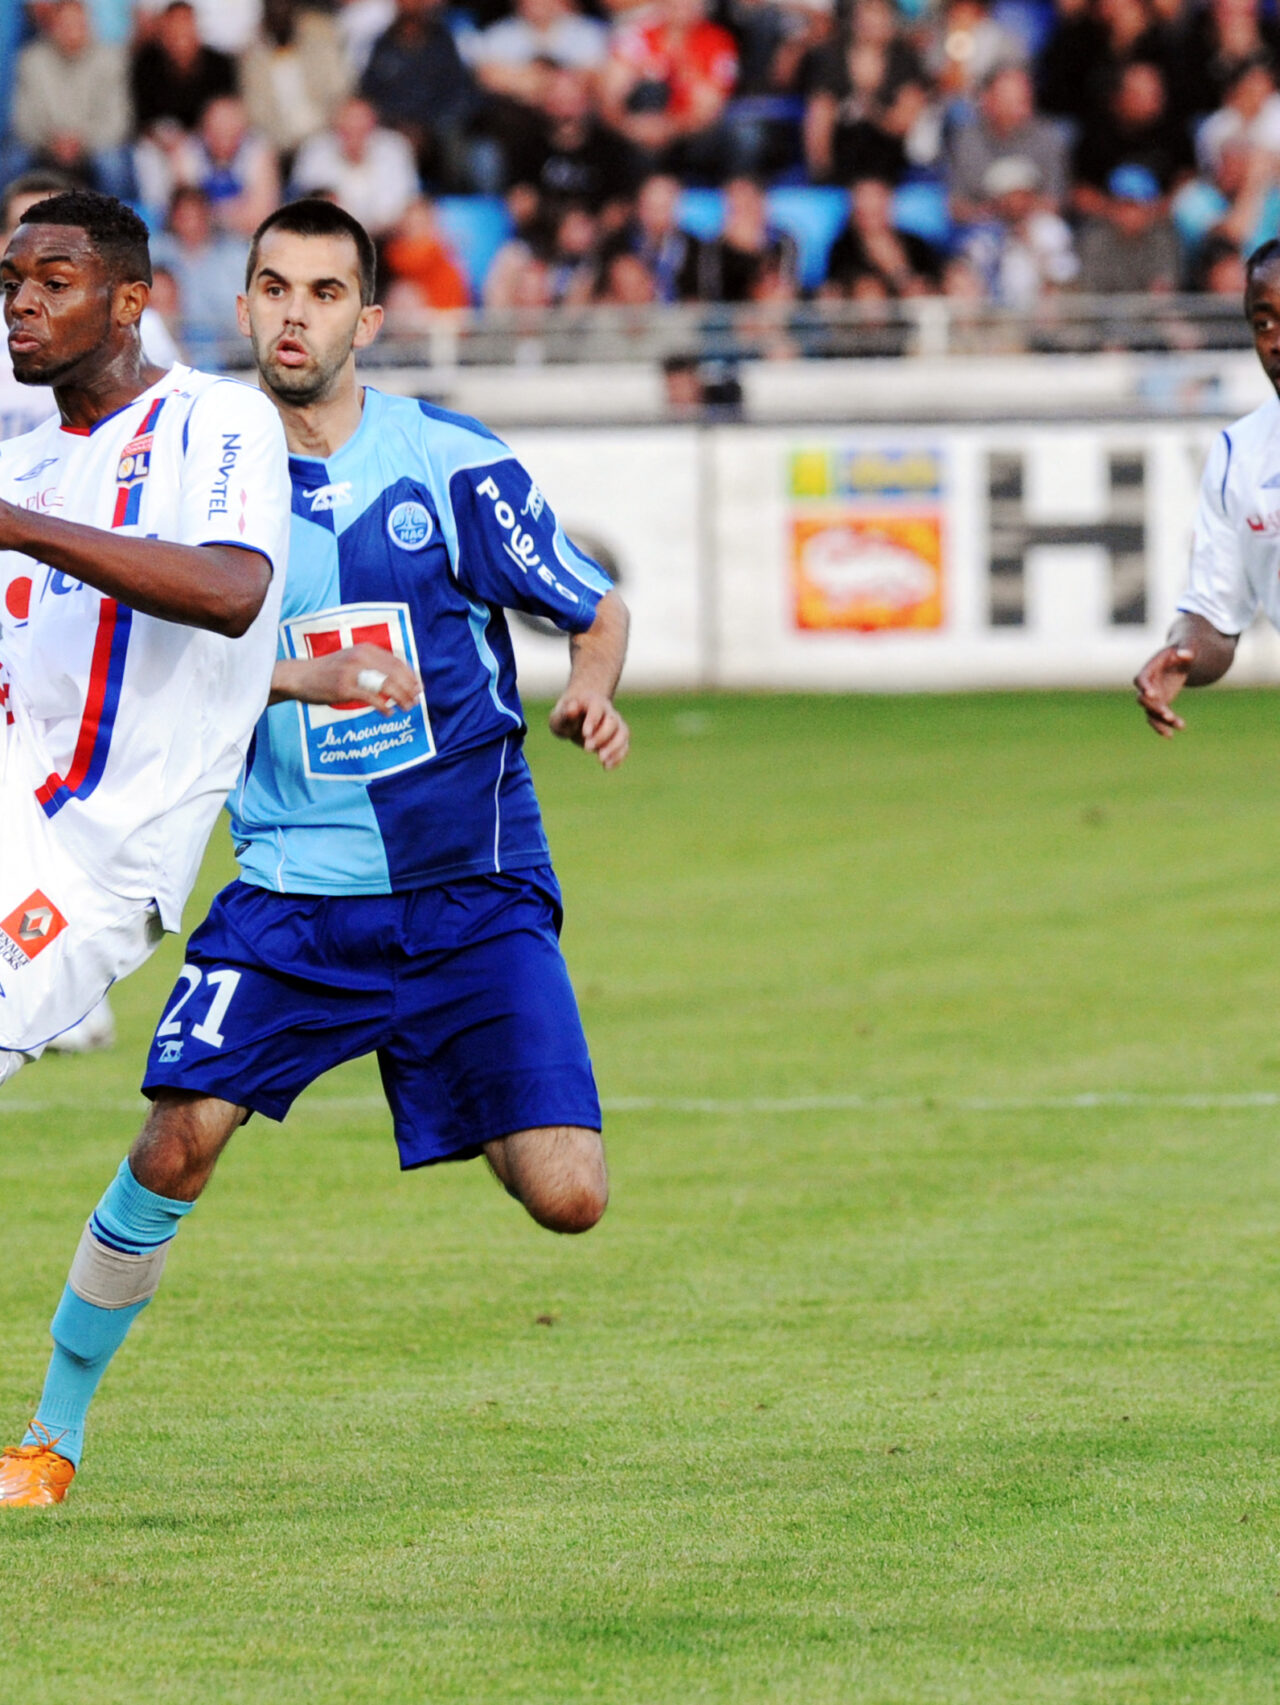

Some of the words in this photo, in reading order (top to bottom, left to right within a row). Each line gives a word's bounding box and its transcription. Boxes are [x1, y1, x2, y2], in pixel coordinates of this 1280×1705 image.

[317, 726, 342, 749] les
[342, 715, 412, 744] nouveaux
[320, 728, 416, 763] commerçants
[156, 963, 242, 1048] 21
